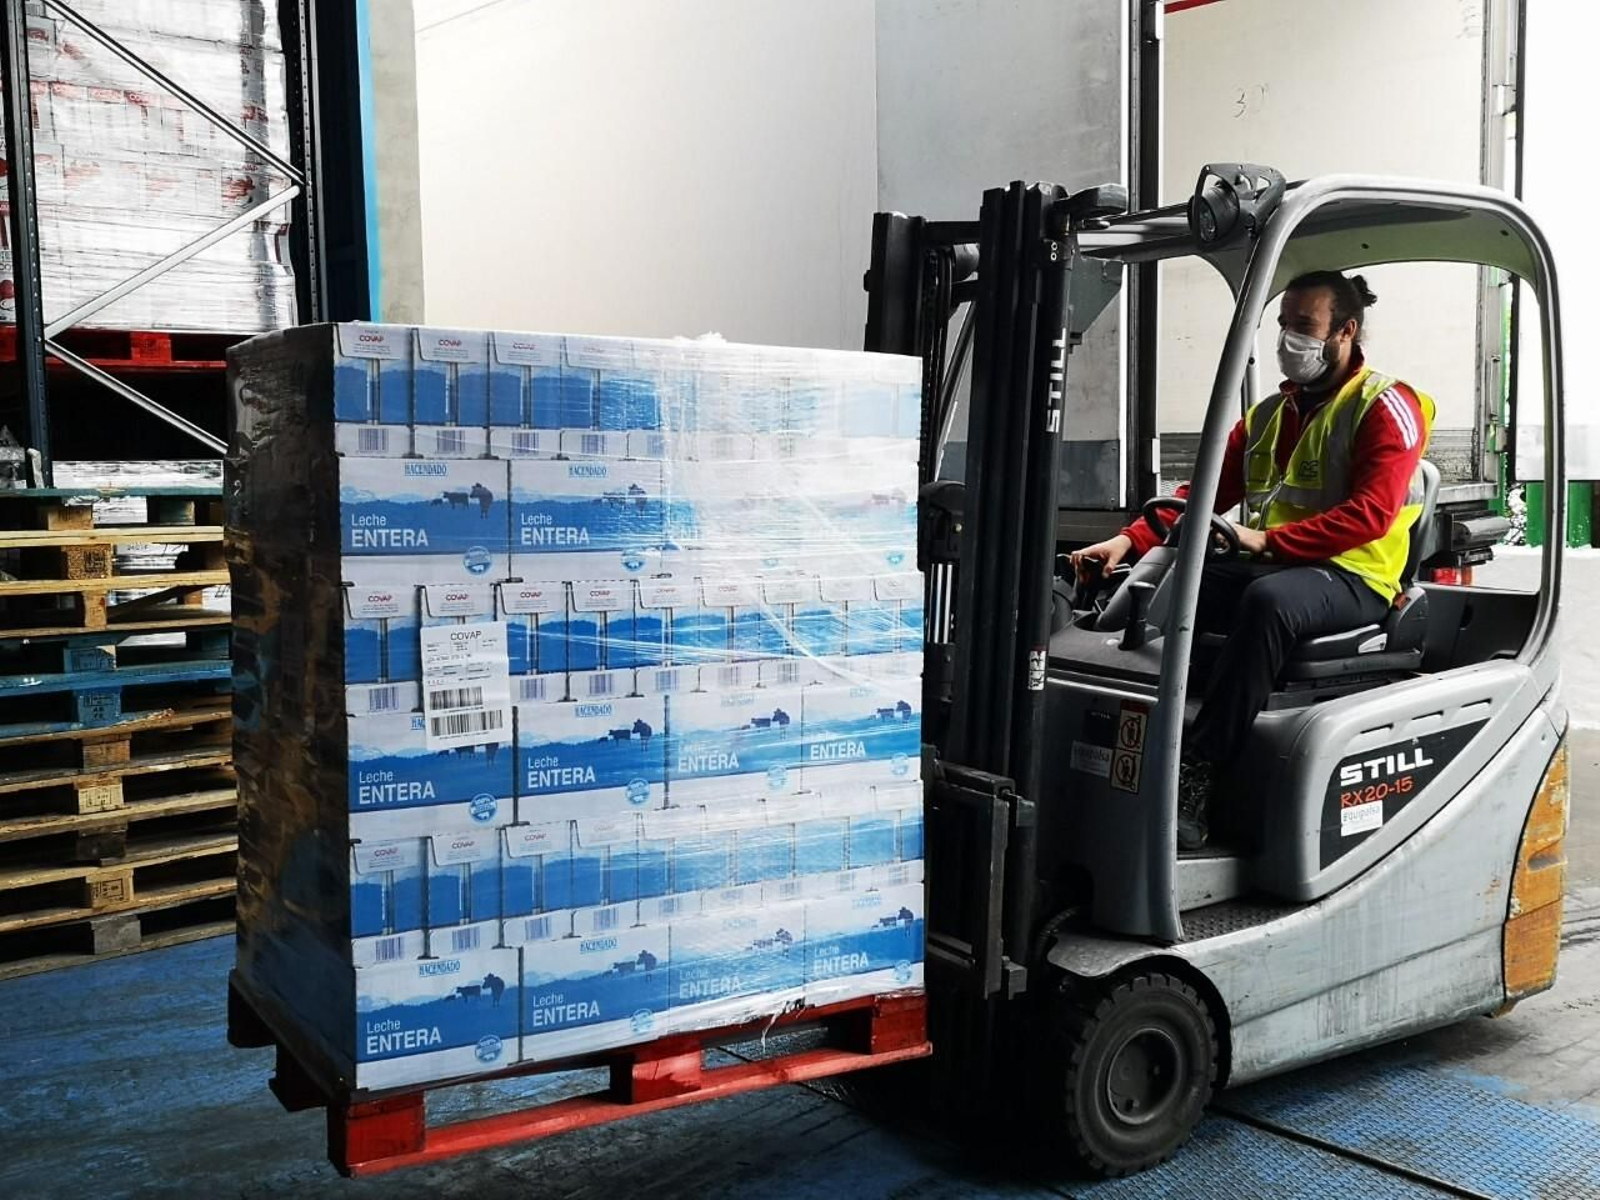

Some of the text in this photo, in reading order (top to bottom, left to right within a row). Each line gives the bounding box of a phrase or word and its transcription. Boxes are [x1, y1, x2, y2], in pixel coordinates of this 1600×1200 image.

[359, 335, 385, 343] COVAP
[438, 339, 462, 348] COVAP
[1046, 327, 1067, 433] STILL
[405, 462, 447, 476] HACENDADO
[351, 514, 387, 527] Leche
[521, 513, 552, 526] Leche
[351, 529, 429, 547] ENTERA
[521, 527, 591, 545] ENTERA
[368, 595, 393, 603] COVAP
[445, 593, 470, 601] COVAP
[520, 591, 543, 599] COVAP
[450, 631, 482, 641] COVAP
[810, 741, 867, 760] ENTERA
[528, 755, 559, 769] Leche
[678, 752, 740, 773] ENTERA
[1340, 747, 1433, 787] STILL
[359, 770, 394, 784] Leche
[528, 767, 596, 789] ENTERA
[359, 781, 436, 805] ENTERA
[1341, 775, 1413, 808] RX20-15
[814, 952, 870, 978] ENTERA
[679, 976, 742, 1000] ENTERA
[533, 992, 564, 1008] Leche
[532, 1000, 600, 1027] ENTERA
[366, 1018, 401, 1034] Leche
[366, 1027, 442, 1055] ENTERA
